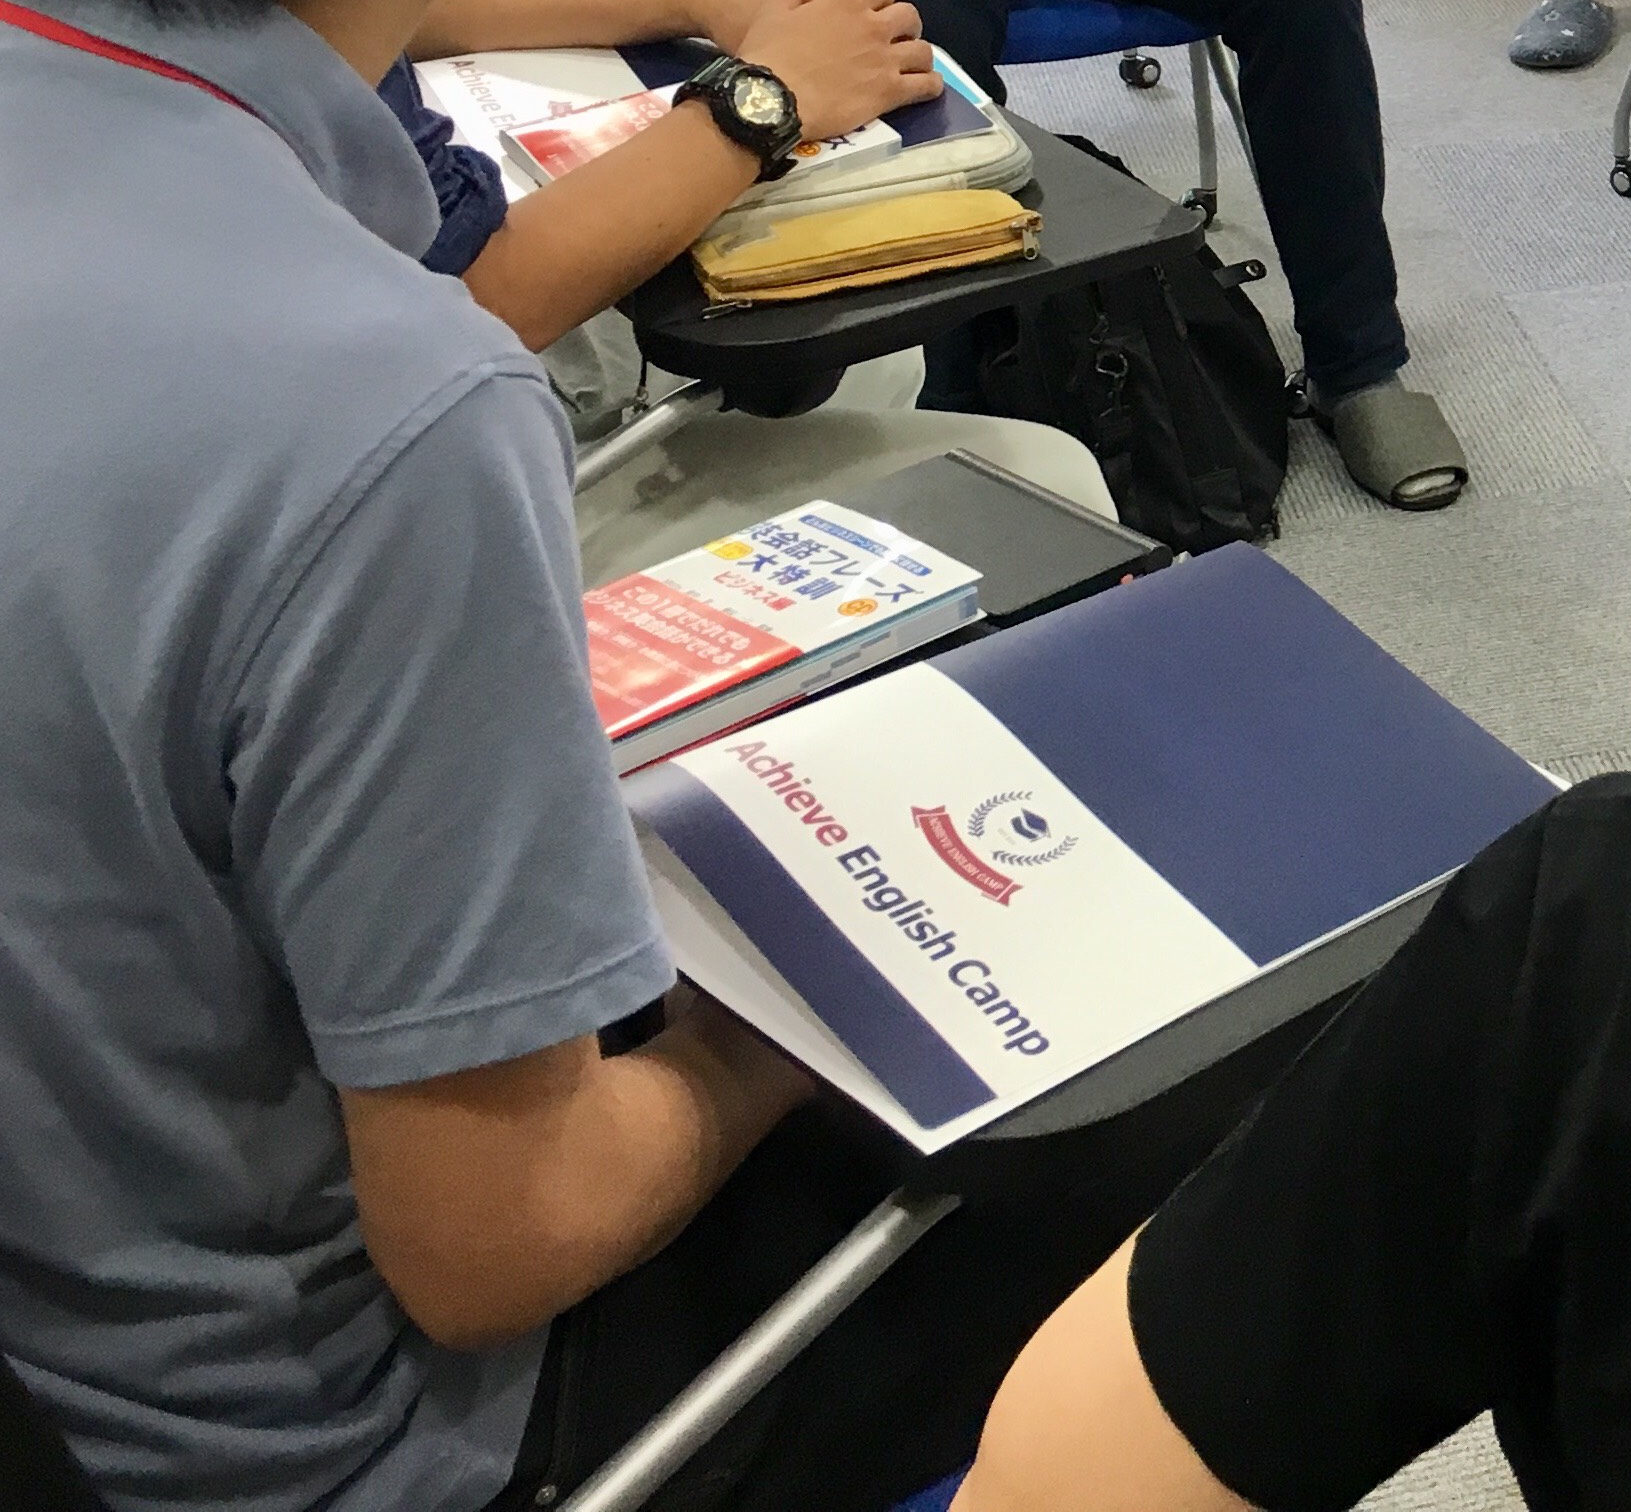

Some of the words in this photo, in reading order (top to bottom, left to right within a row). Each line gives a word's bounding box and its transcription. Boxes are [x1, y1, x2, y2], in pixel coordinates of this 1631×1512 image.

[449, 60, 501, 113] Achieve
[724, 741, 848, 847] Achieve
[835, 844, 957, 962] English
[948, 959, 1050, 1056] Camp
